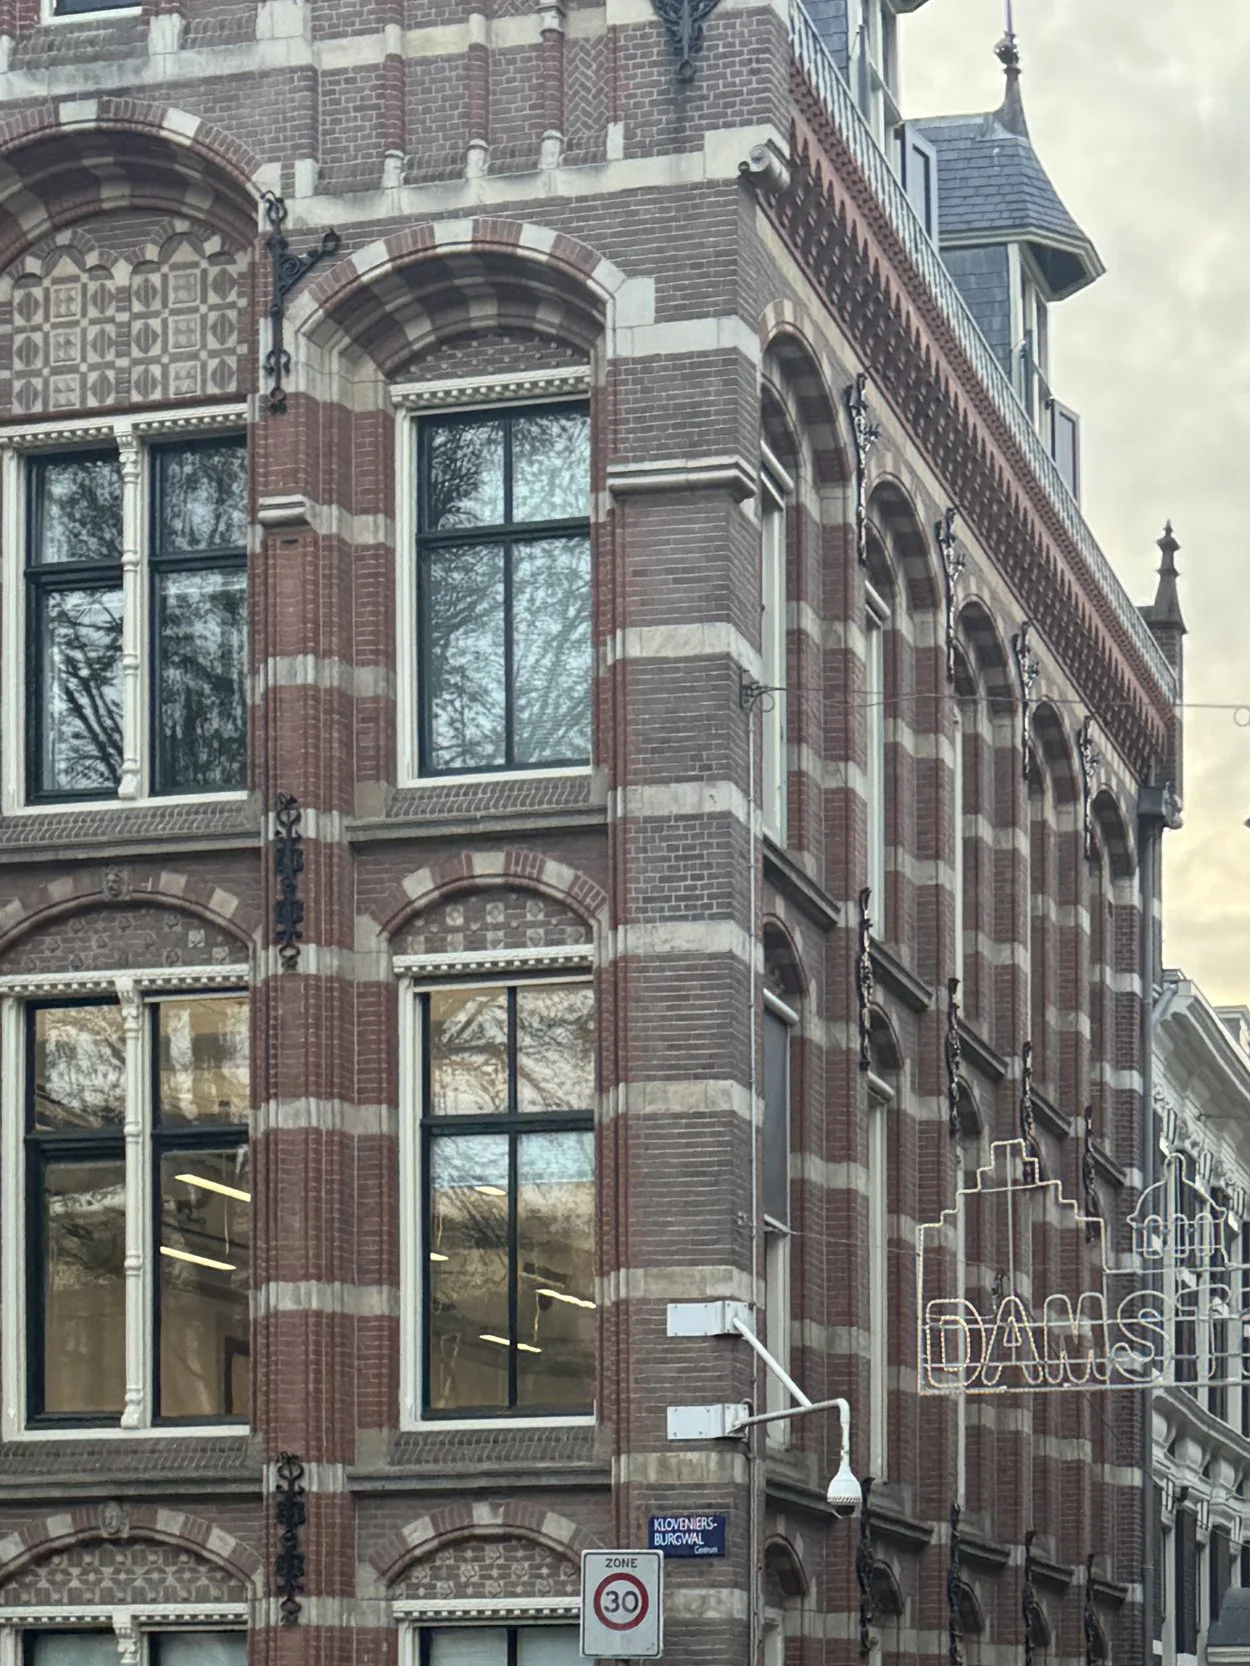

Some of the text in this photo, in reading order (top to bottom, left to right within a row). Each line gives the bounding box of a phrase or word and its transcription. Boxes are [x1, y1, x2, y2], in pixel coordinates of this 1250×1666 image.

[653, 1516, 718, 1531] KLOVENIERS-
[653, 1532, 705, 1546] BURGWAL
[694, 1544, 718, 1554] Centrum
[605, 1557, 638, 1569] ZONE
[603, 1590, 639, 1614] 30
